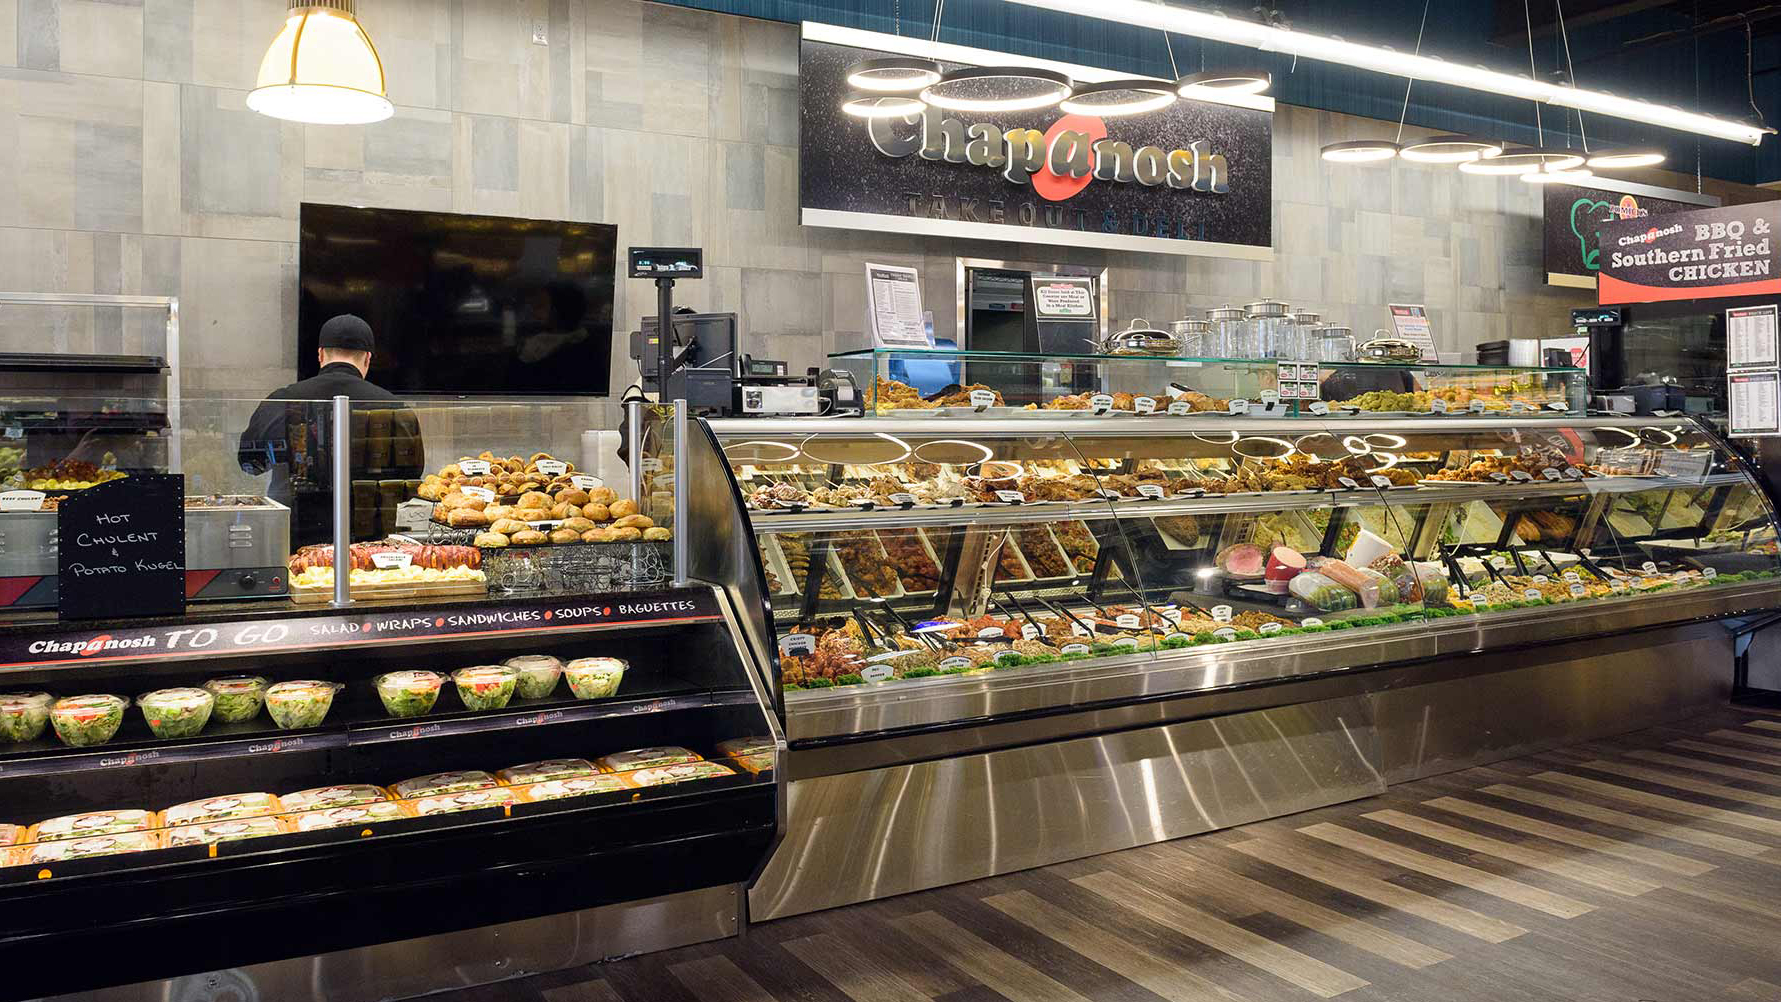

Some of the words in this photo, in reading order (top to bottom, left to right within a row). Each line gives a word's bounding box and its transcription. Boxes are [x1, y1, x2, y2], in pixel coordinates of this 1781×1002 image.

[867, 98, 1229, 193] Chapanosh
[1102, 208, 1119, 233] &
[1132, 213, 1207, 241] DELI
[1618, 224, 1683, 246] Chapanosh
[1695, 221, 1745, 241] BBQ
[1753, 218, 1770, 235] &
[1612, 248, 1705, 268] Southern
[1709, 238, 1771, 259] Fried
[1669, 260, 1771, 281] CHICKEN
[96, 513, 130, 525] HOT
[77, 532, 158, 547] CHULENT
[69, 563, 127, 577] POTATO
[135, 559, 184, 571] KUGEL
[309, 622, 359, 636] SALAD
[376, 617, 432, 631] WRAPS
[447, 610, 541, 627] SANDWICHES
[555, 606, 602, 619] SOUPS
[618, 600, 696, 615] BAGUETTES
[28, 635, 156, 654] Chapanosh
[165, 629, 218, 648] TO
[234, 624, 289, 645] GO
[248, 737, 304, 753] Chapanosh
[100, 751, 160, 766] Chapanosh
